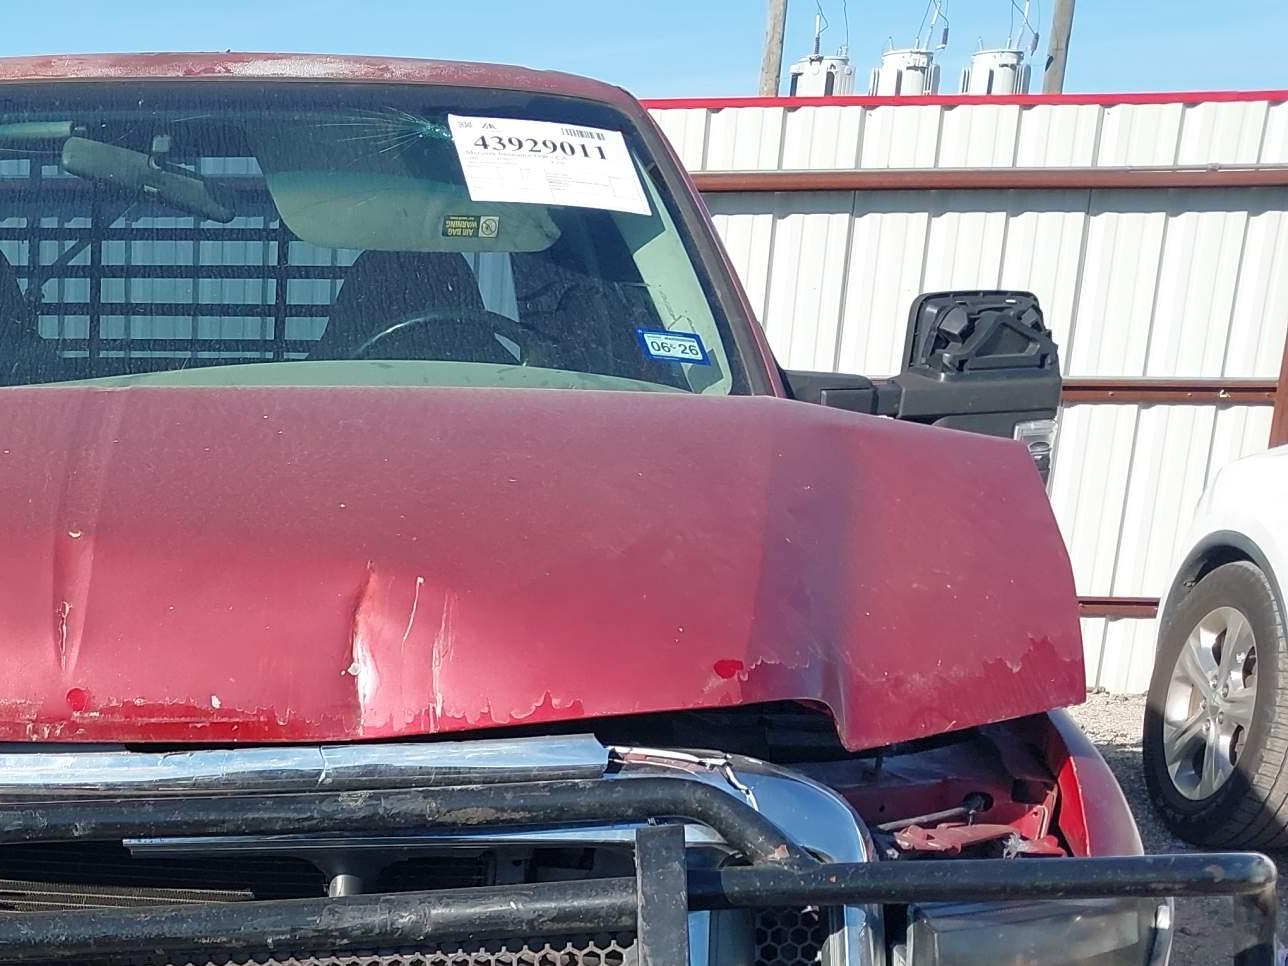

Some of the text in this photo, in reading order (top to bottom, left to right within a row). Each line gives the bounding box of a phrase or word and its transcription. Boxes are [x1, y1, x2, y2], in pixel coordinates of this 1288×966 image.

[473, 135, 607, 161] 43929011
[651, 341, 699, 356] 06 26
